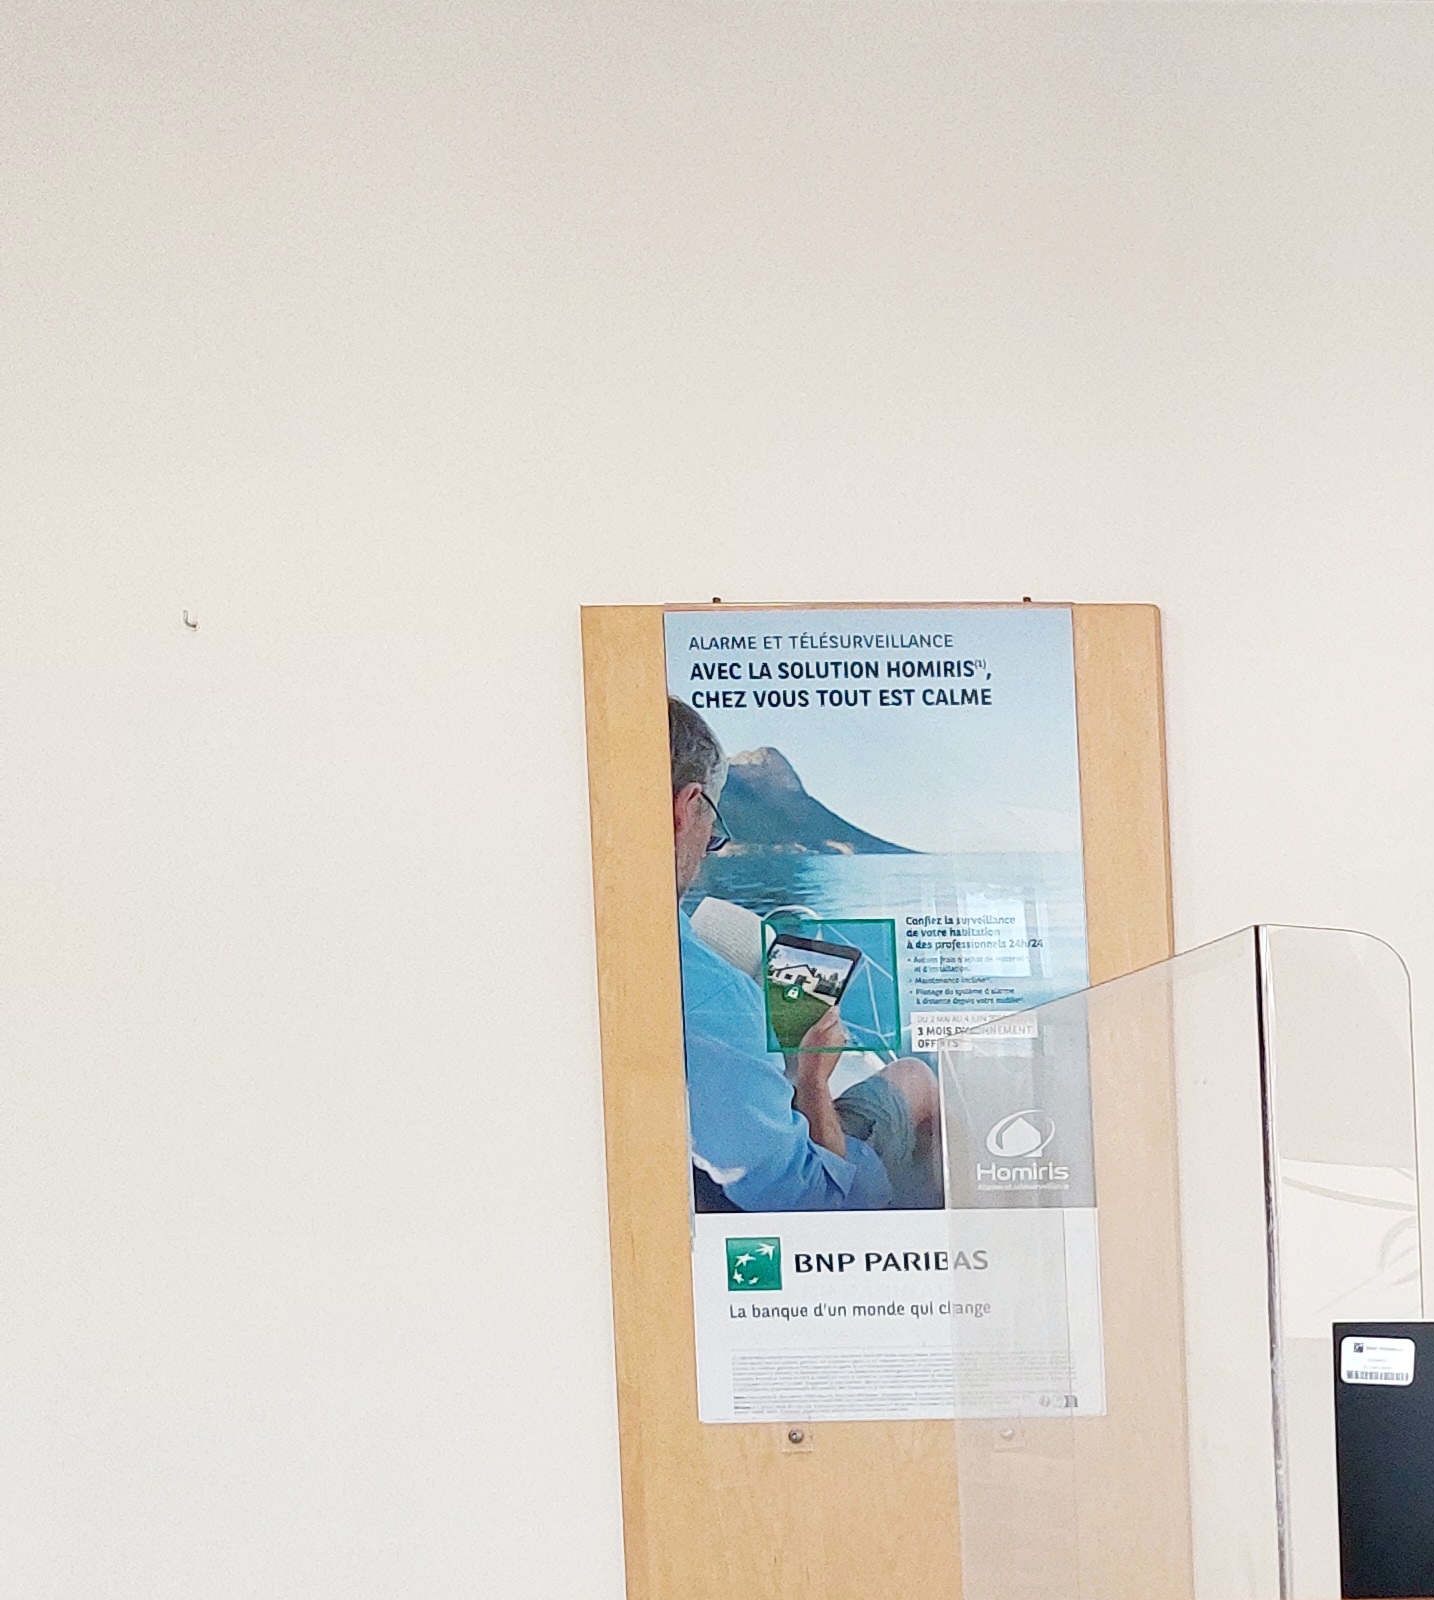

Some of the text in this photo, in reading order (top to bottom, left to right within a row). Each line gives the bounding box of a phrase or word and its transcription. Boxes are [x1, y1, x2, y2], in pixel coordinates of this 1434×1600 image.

[688, 632, 954, 650] ALARME ET TÉLÉSURVEILLANCE
[690, 662, 742, 681] AVEC
[749, 662, 772, 680] LA
[777, 661, 879, 680] SOLUTION
[691, 688, 992, 708] CHEZ VOUS TOUT EST CALME
[906, 916, 942, 927] Confiez
[944, 916, 954, 925] la
[906, 927, 1000, 937] de votre habitation
[916, 939, 933, 949] des
[917, 1026, 924, 1036] 3
[926, 1026, 952, 1036] MOIS
[976, 1161, 1069, 1181] Homiris
[794, 1249, 989, 1274] BNP PARIBAS
[729, 1304, 747, 1319] La
[752, 1303, 808, 1321] banque
[813, 1303, 847, 1317] d'un
[853, 1301, 905, 1316] monde
[910, 1301, 934, 1319] qui
